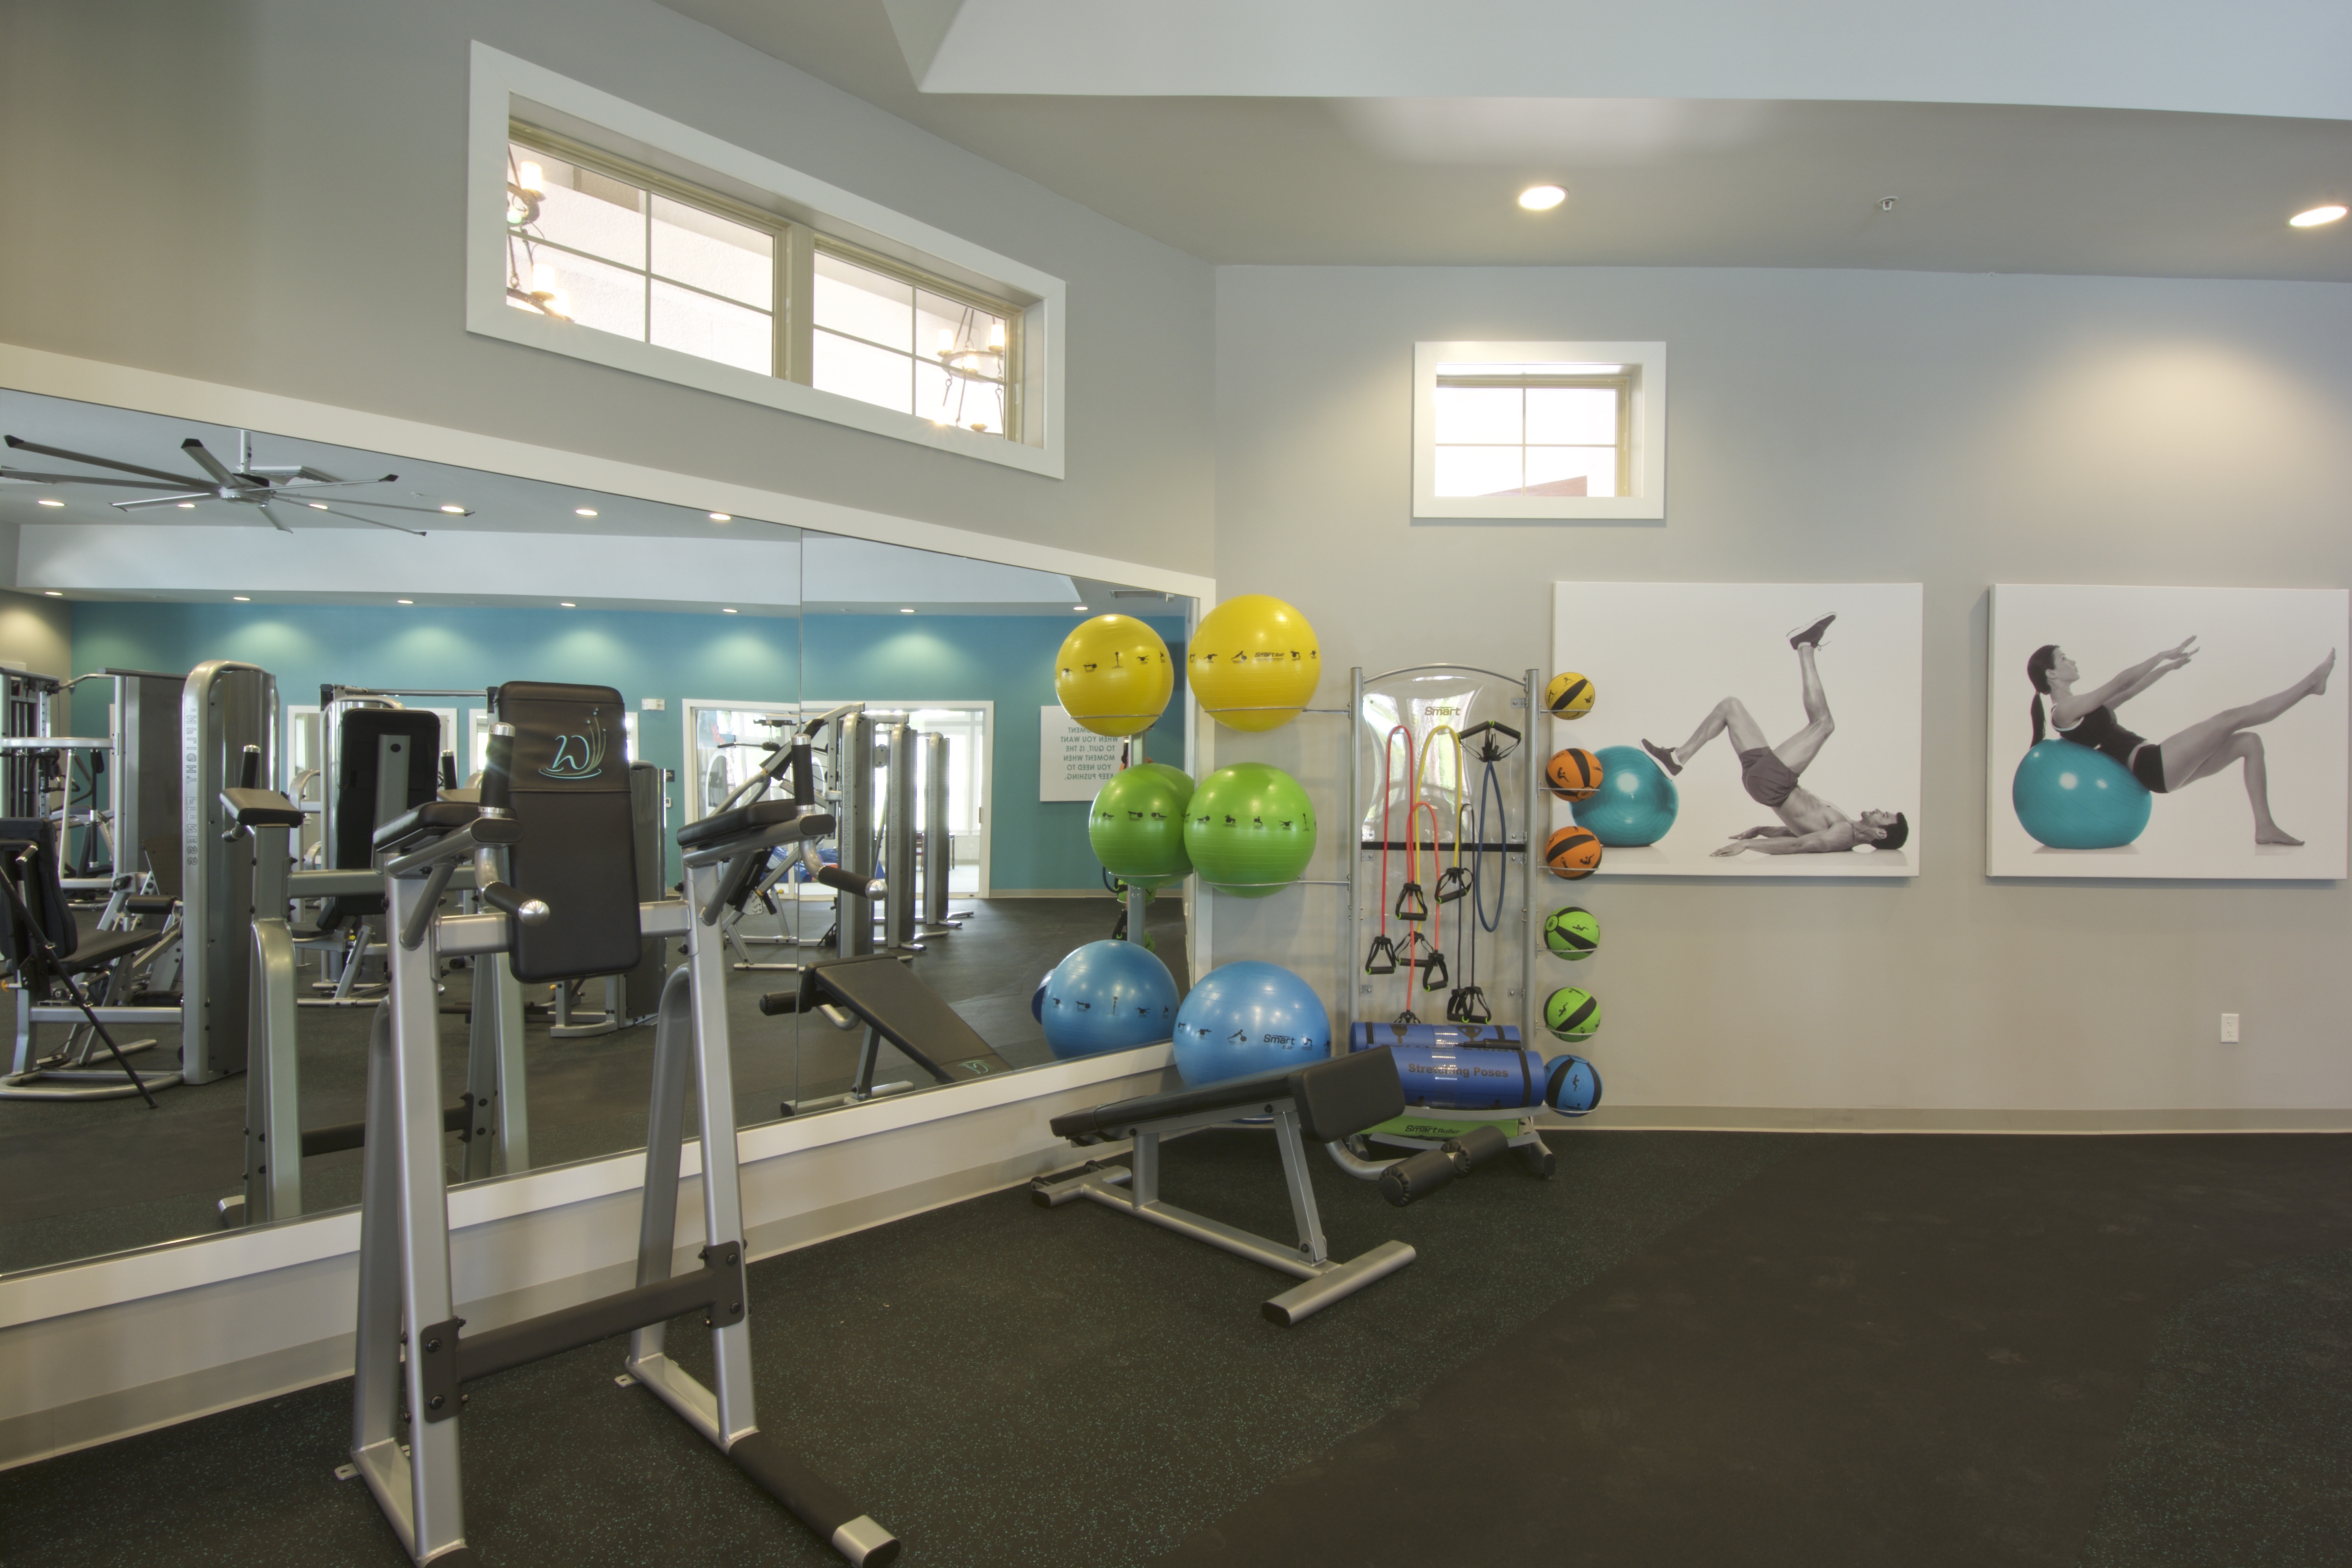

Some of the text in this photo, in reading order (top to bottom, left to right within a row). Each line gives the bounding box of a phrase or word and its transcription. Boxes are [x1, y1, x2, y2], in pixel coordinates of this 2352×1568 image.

[1425, 706, 1461, 715] Smart
[1264, 1034, 1295, 1045] Smart
[1474, 1067, 1508, 1077] Poses
